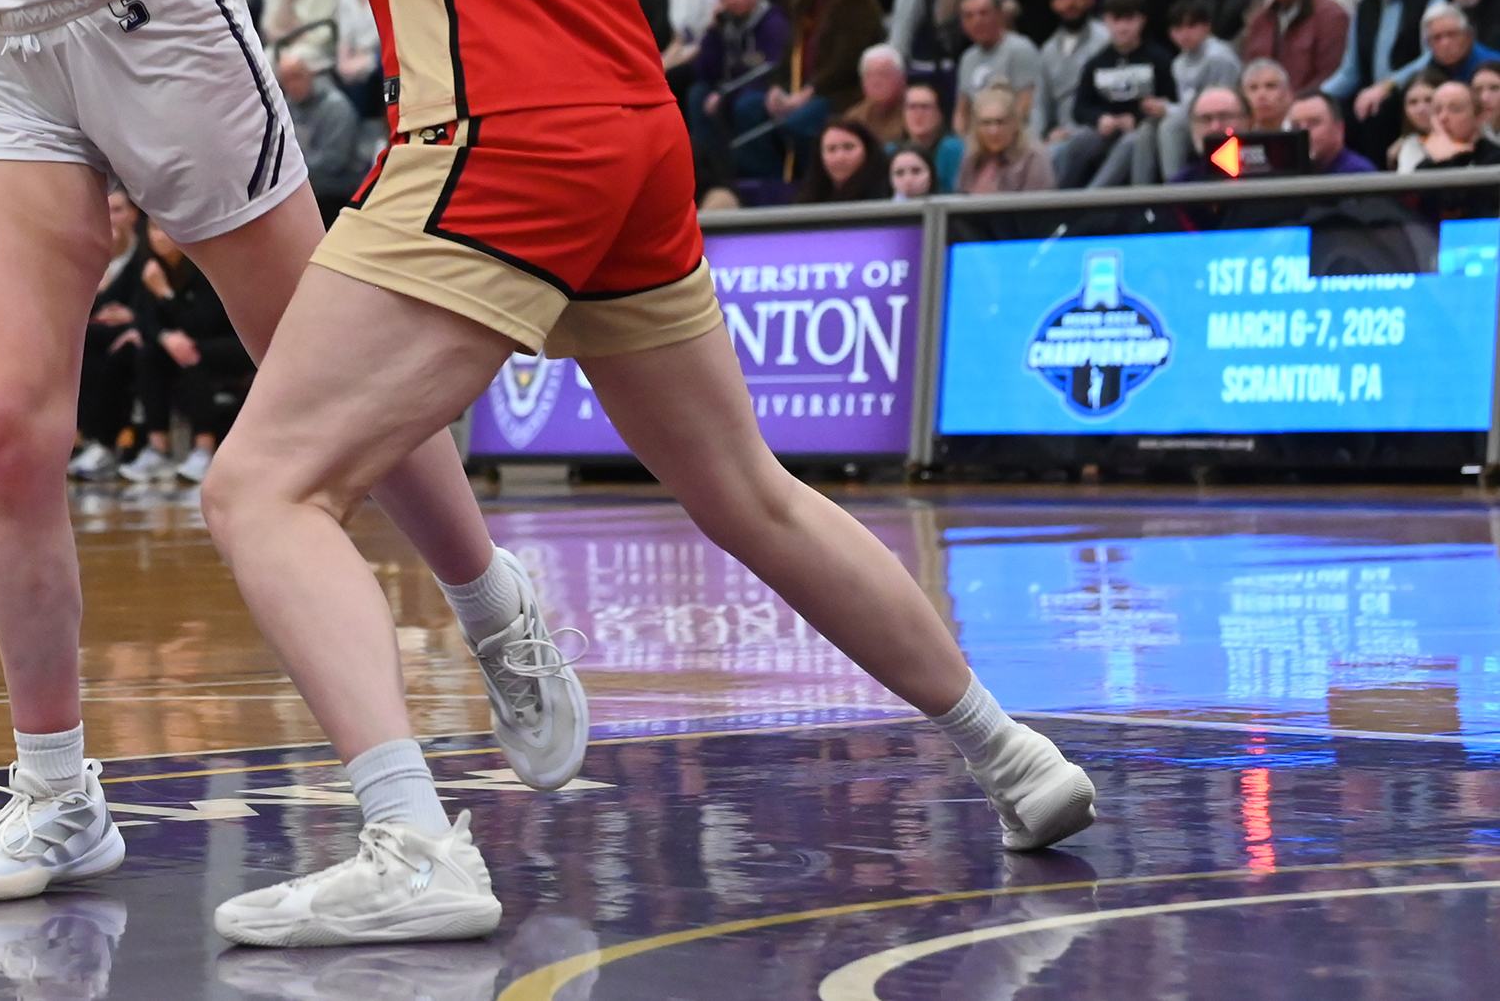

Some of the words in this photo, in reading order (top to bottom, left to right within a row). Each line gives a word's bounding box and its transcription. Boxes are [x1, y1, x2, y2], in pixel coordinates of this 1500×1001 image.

[861, 259, 910, 289] OF
[1207, 256, 1248, 296] 1ST
[722, 295, 910, 384] NTON
[1206, 310, 1285, 350] MARCH
[1290, 309, 1337, 352] 6-7,
[1342, 306, 1406, 347] 2026
[1220, 364, 1346, 406] SCRANTON,
[1350, 363, 1383, 402] PA
